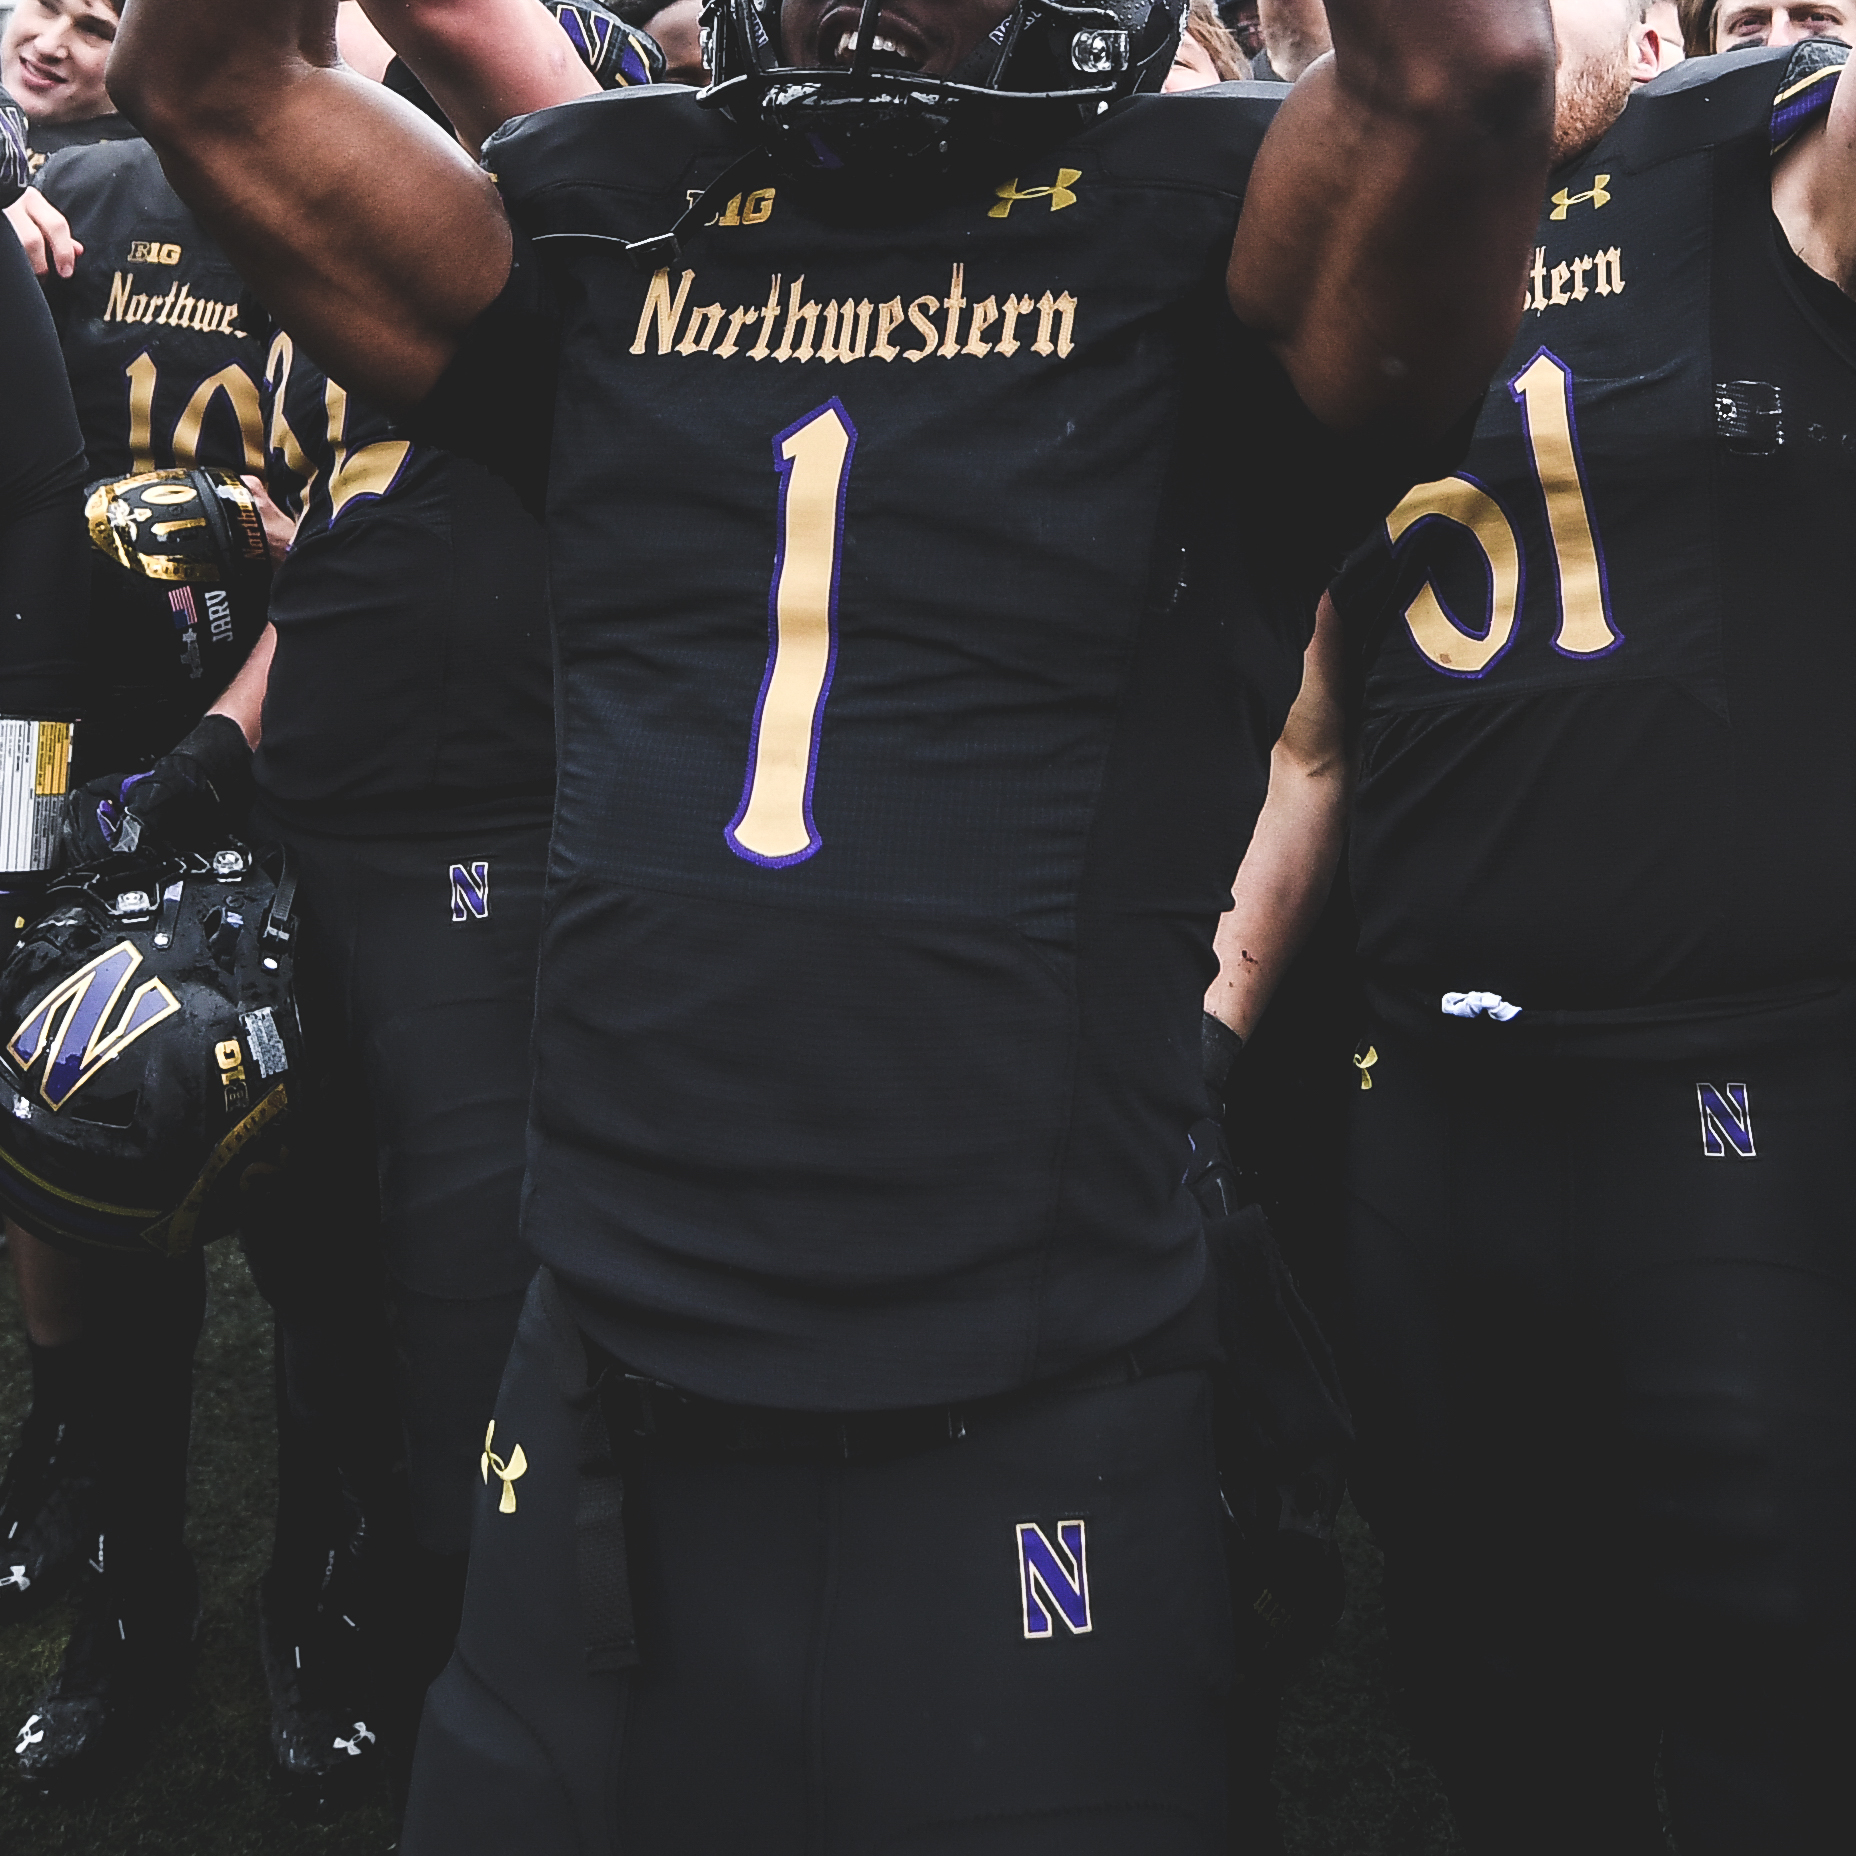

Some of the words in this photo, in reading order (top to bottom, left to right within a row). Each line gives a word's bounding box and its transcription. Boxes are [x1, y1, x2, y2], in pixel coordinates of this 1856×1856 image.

[127, 241, 181, 267] B1G
[103, 271, 248, 339] Northwe
[629, 262, 1078, 364] Northwestern
[125, 350, 267, 477] 10
[205, 590, 234, 643] JARV
[724, 395, 858, 870] 1
[449, 862, 489, 921] N
[6, 940, 182, 1112] N
[1696, 1082, 1756, 1157] N
[1015, 1520, 1093, 1639] N
